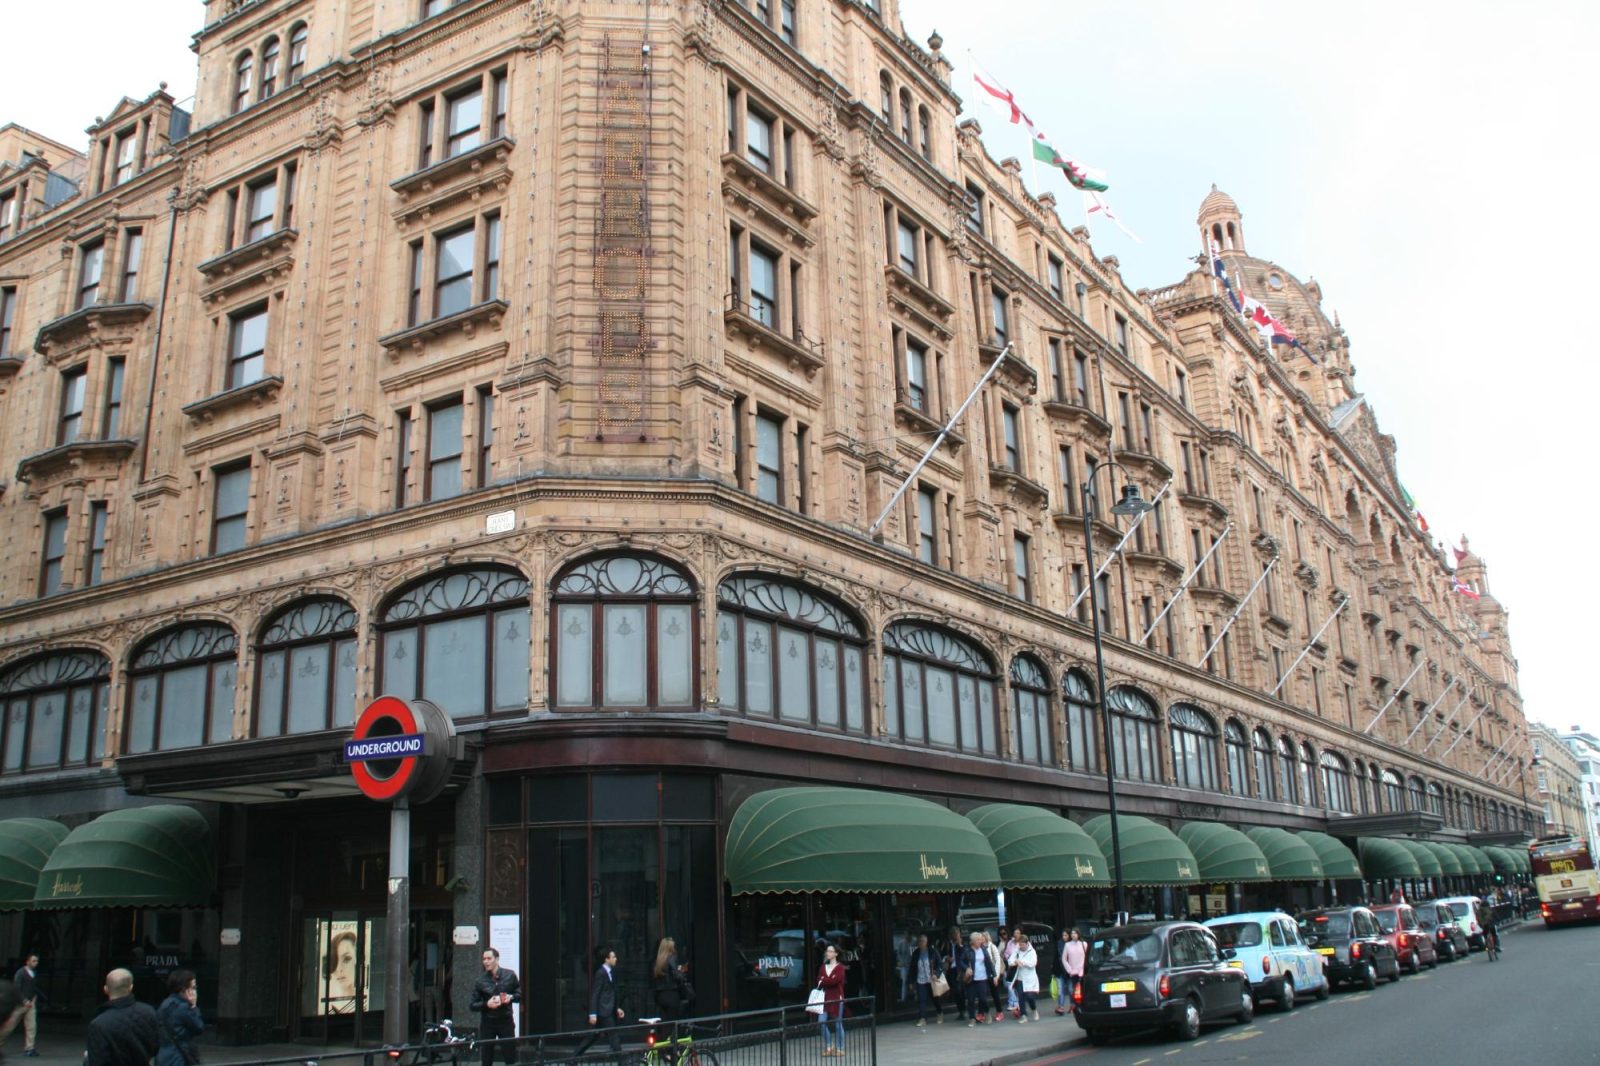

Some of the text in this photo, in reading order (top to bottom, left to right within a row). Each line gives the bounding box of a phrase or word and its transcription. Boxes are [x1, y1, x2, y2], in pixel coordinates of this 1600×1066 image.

[593, 28, 650, 427] HARRODS
[347, 739, 421, 757] UNDERGROUND
[920, 853, 949, 880] Harrods
[1074, 856, 1094, 878] Harrods
[52, 872, 84, 897] Harrods
[145, 955, 179, 967] PRADA
[758, 956, 795, 970] PRADA
